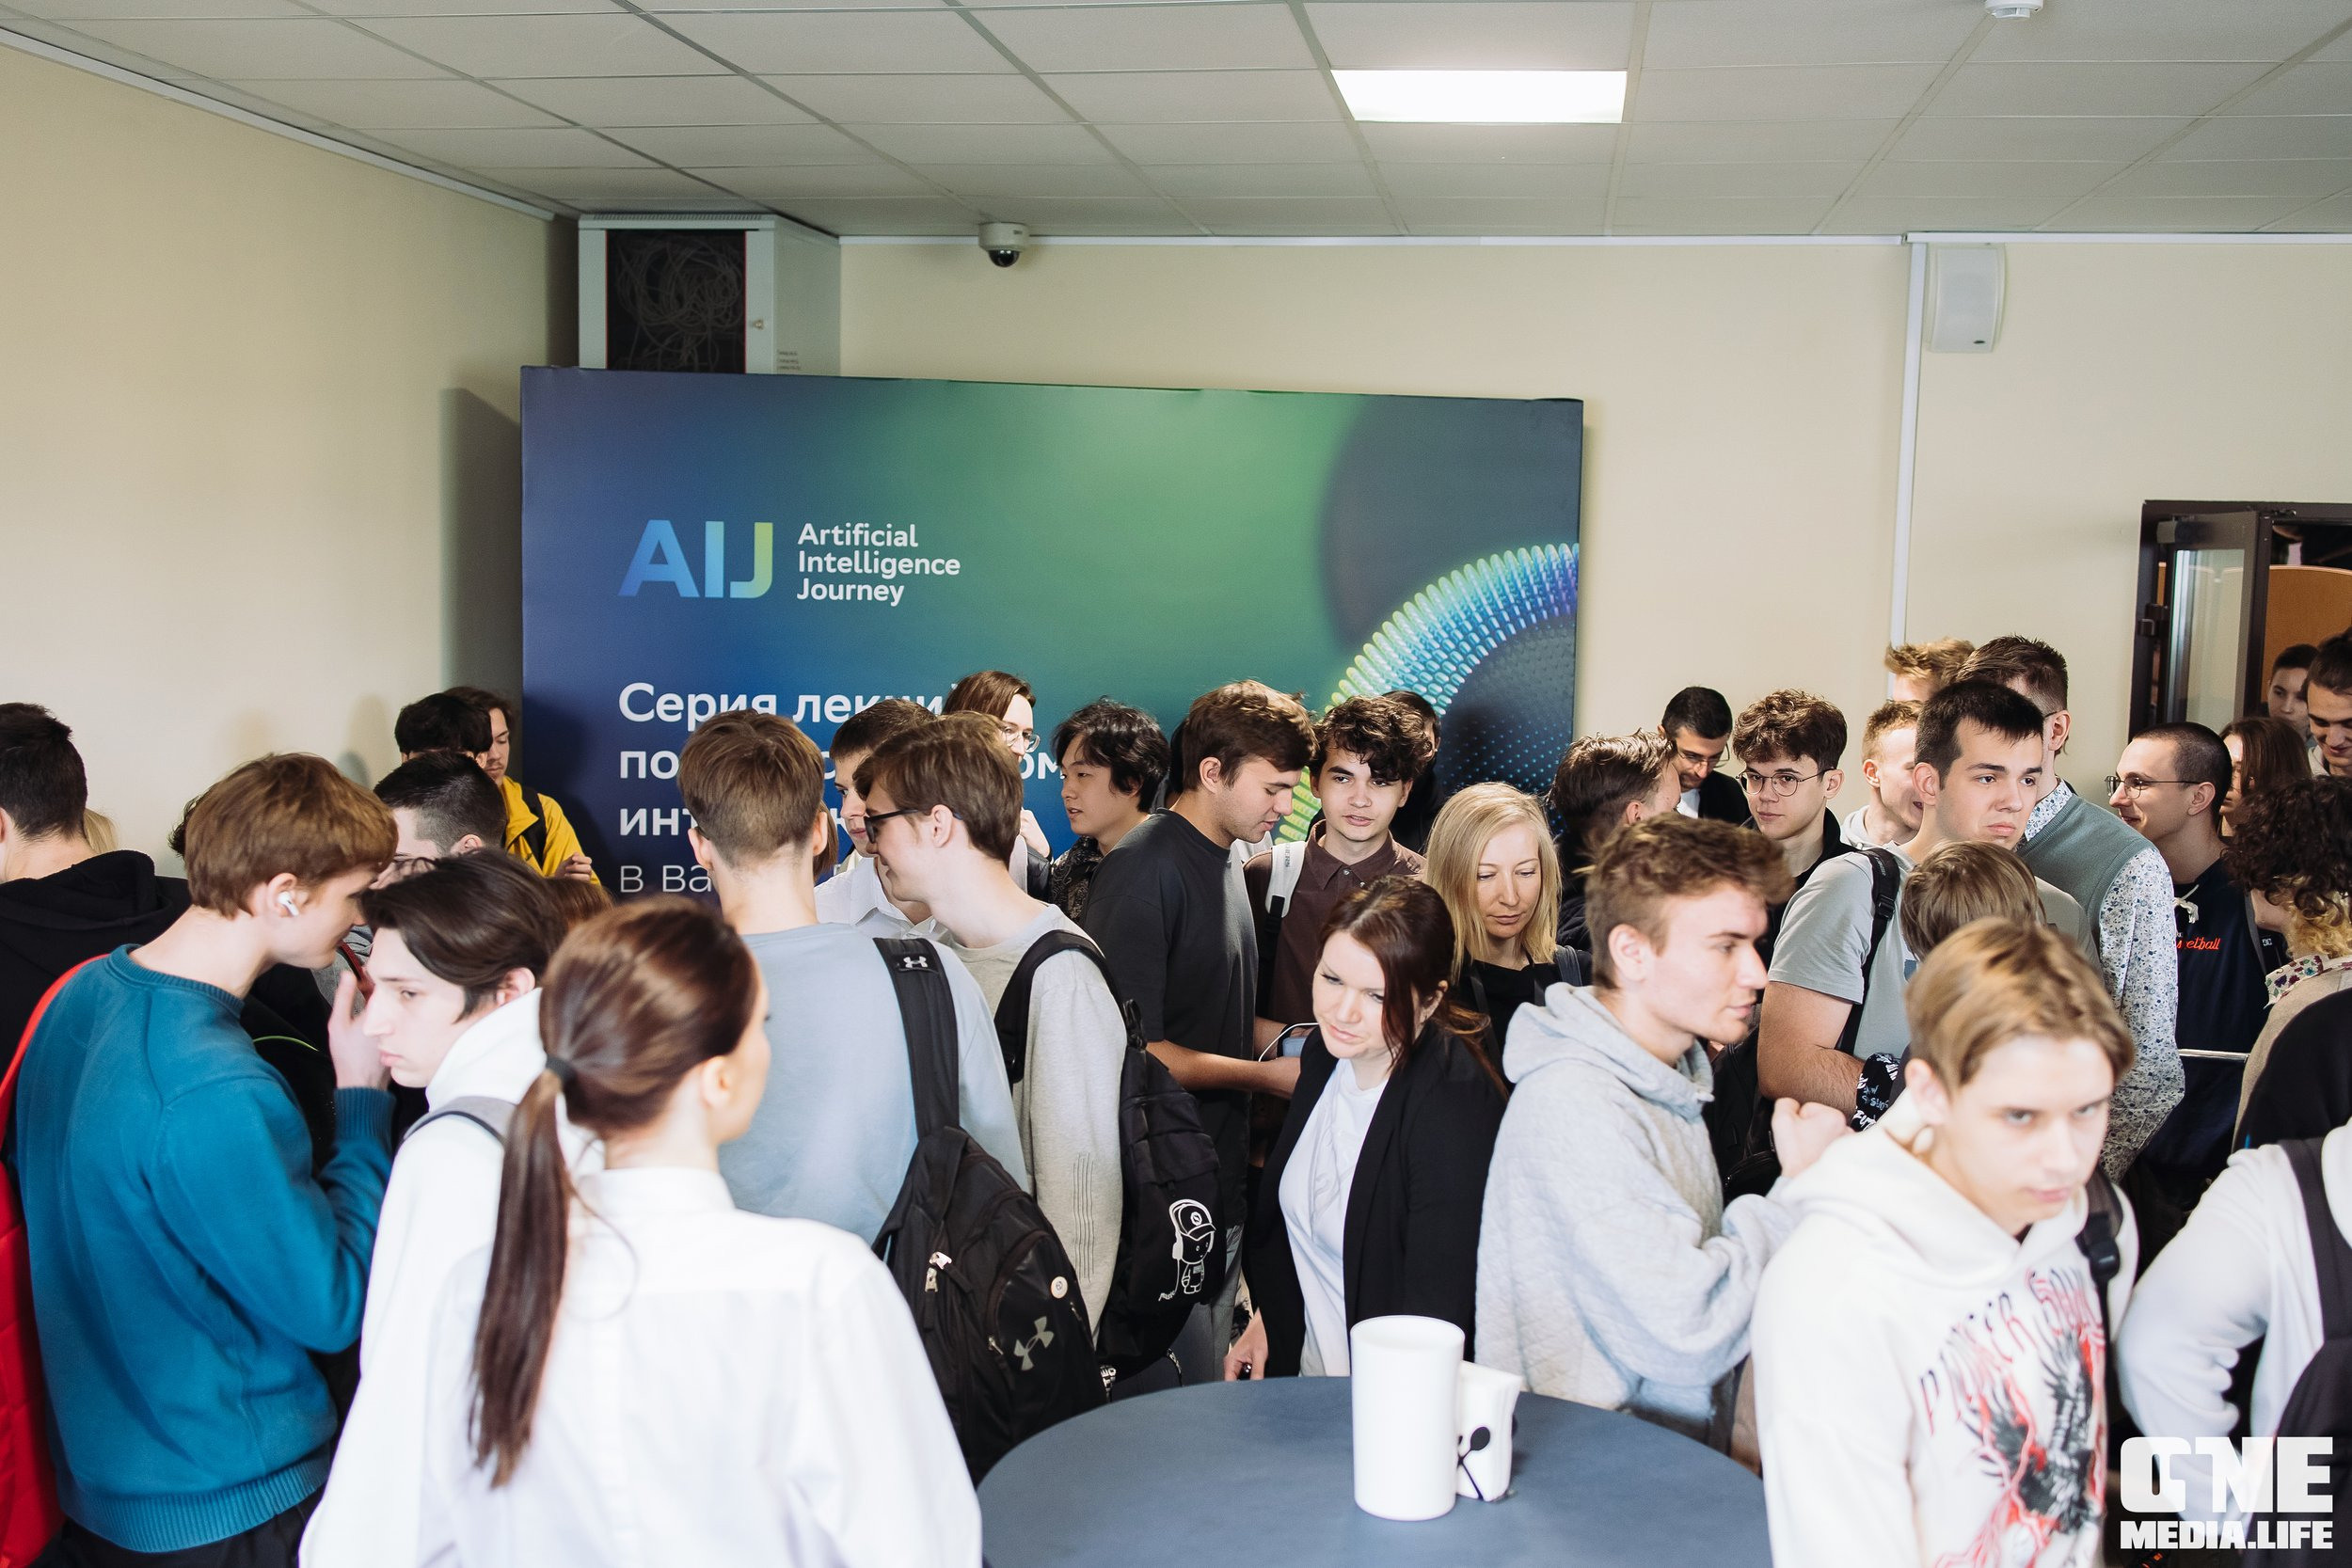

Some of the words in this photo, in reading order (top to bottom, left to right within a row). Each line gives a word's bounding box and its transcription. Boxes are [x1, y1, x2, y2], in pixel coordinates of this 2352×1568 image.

[797, 522, 919, 548] Artificial
[617, 518, 773, 598] AIJ
[799, 549, 961, 579] Intelligence
[797, 578, 905, 607] Journey
[618, 682, 777, 732] Серия
[620, 750, 679, 780] по
[620, 864, 644, 893] в
